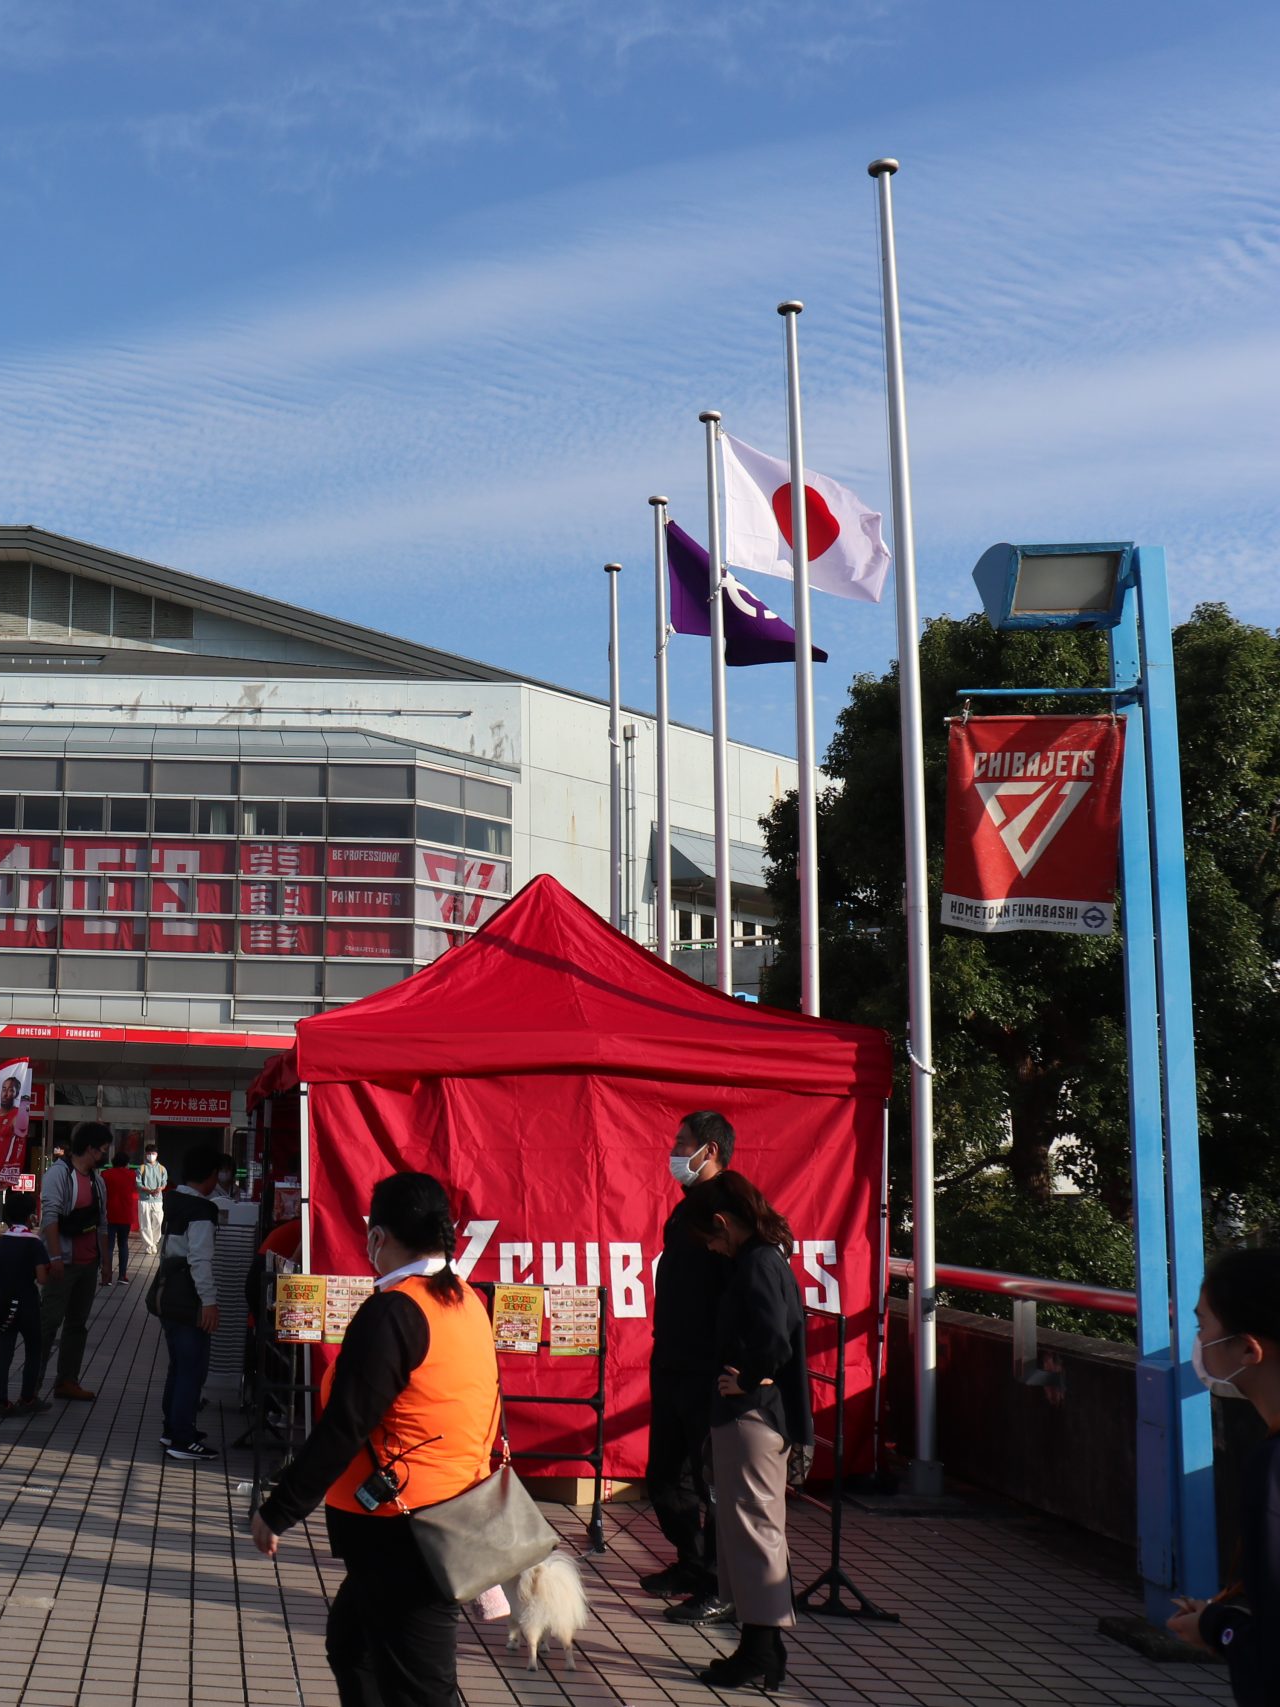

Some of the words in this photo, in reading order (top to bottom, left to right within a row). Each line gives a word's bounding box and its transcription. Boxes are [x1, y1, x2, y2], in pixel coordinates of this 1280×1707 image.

[974, 750, 1096, 778] CHIBAJETS
[332, 849, 343, 861] BE
[344, 849, 402, 863] PROFESSIONAL
[331, 890, 360, 904] PAINT
[364, 890, 372, 904] IT
[376, 891, 401, 906] JETS
[950, 900, 1010, 919] HOMETOWN
[1012, 903, 1078, 920] FUNABASHI
[16, 1027, 51, 1036] HOMETOWN
[65, 1029, 101, 1038] FUNABASHI
[153, 1097, 228, 1111] チケット総合窓口
[498, 1240, 841, 1318] CHIBS
[282, 1283, 319, 1292] AUTUMN
[501, 1294, 537, 1304] AUTUMN
